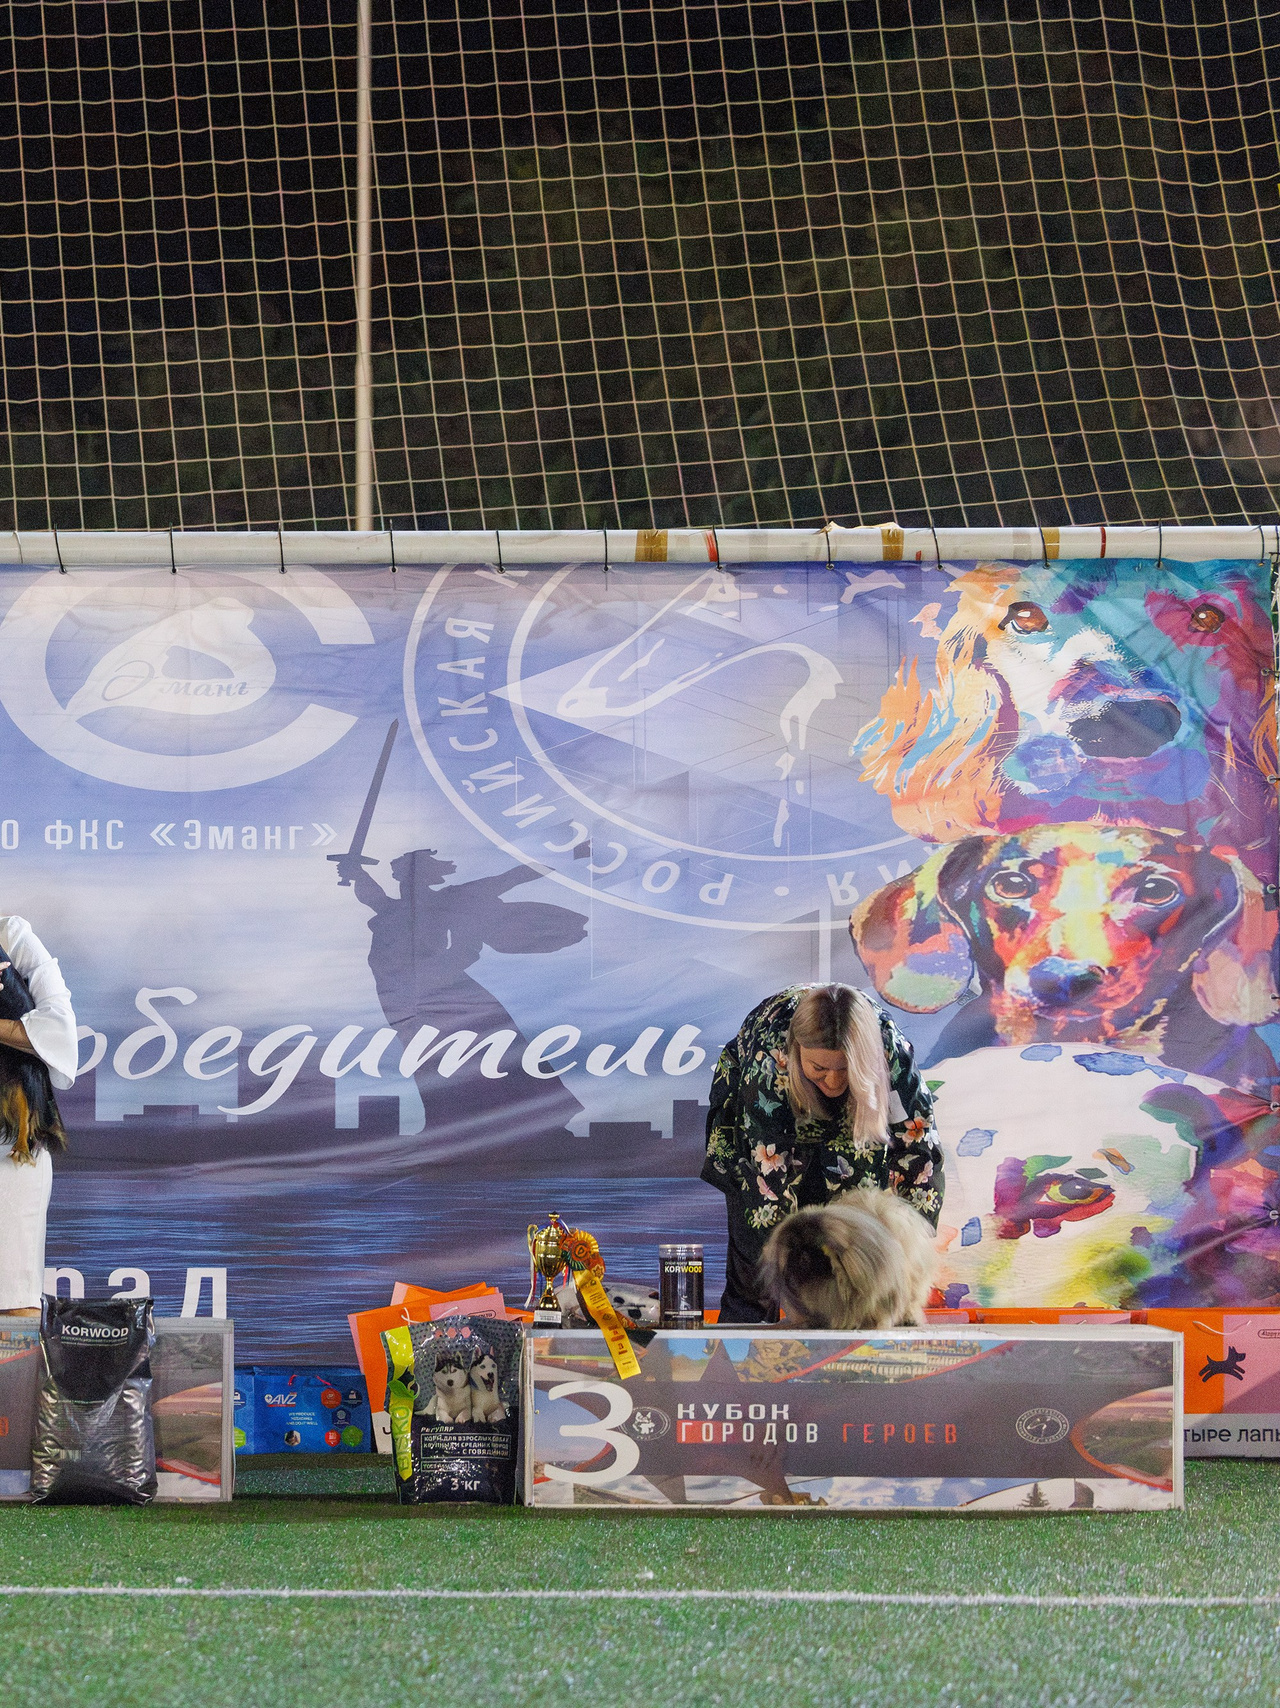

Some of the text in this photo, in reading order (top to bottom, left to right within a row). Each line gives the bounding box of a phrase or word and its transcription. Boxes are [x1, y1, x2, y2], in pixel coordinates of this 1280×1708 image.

[435, 616, 733, 906] РОССИЙСКАЯ
[44, 818, 124, 850] ФКС
[149, 819, 338, 850] «Эманг»
[665, 1265, 702, 1273] KORWOOD
[62, 1324, 128, 1338] KORWOOD
[271, 1394, 297, 1405] AVZ
[677, 1403, 790, 1420] КУБОК
[544, 1381, 641, 1486] 3
[677, 1421, 818, 1445] ГОРОДОВ
[841, 1423, 958, 1444] ГЕРОЕВ
[450, 1478, 459, 1491] 3
